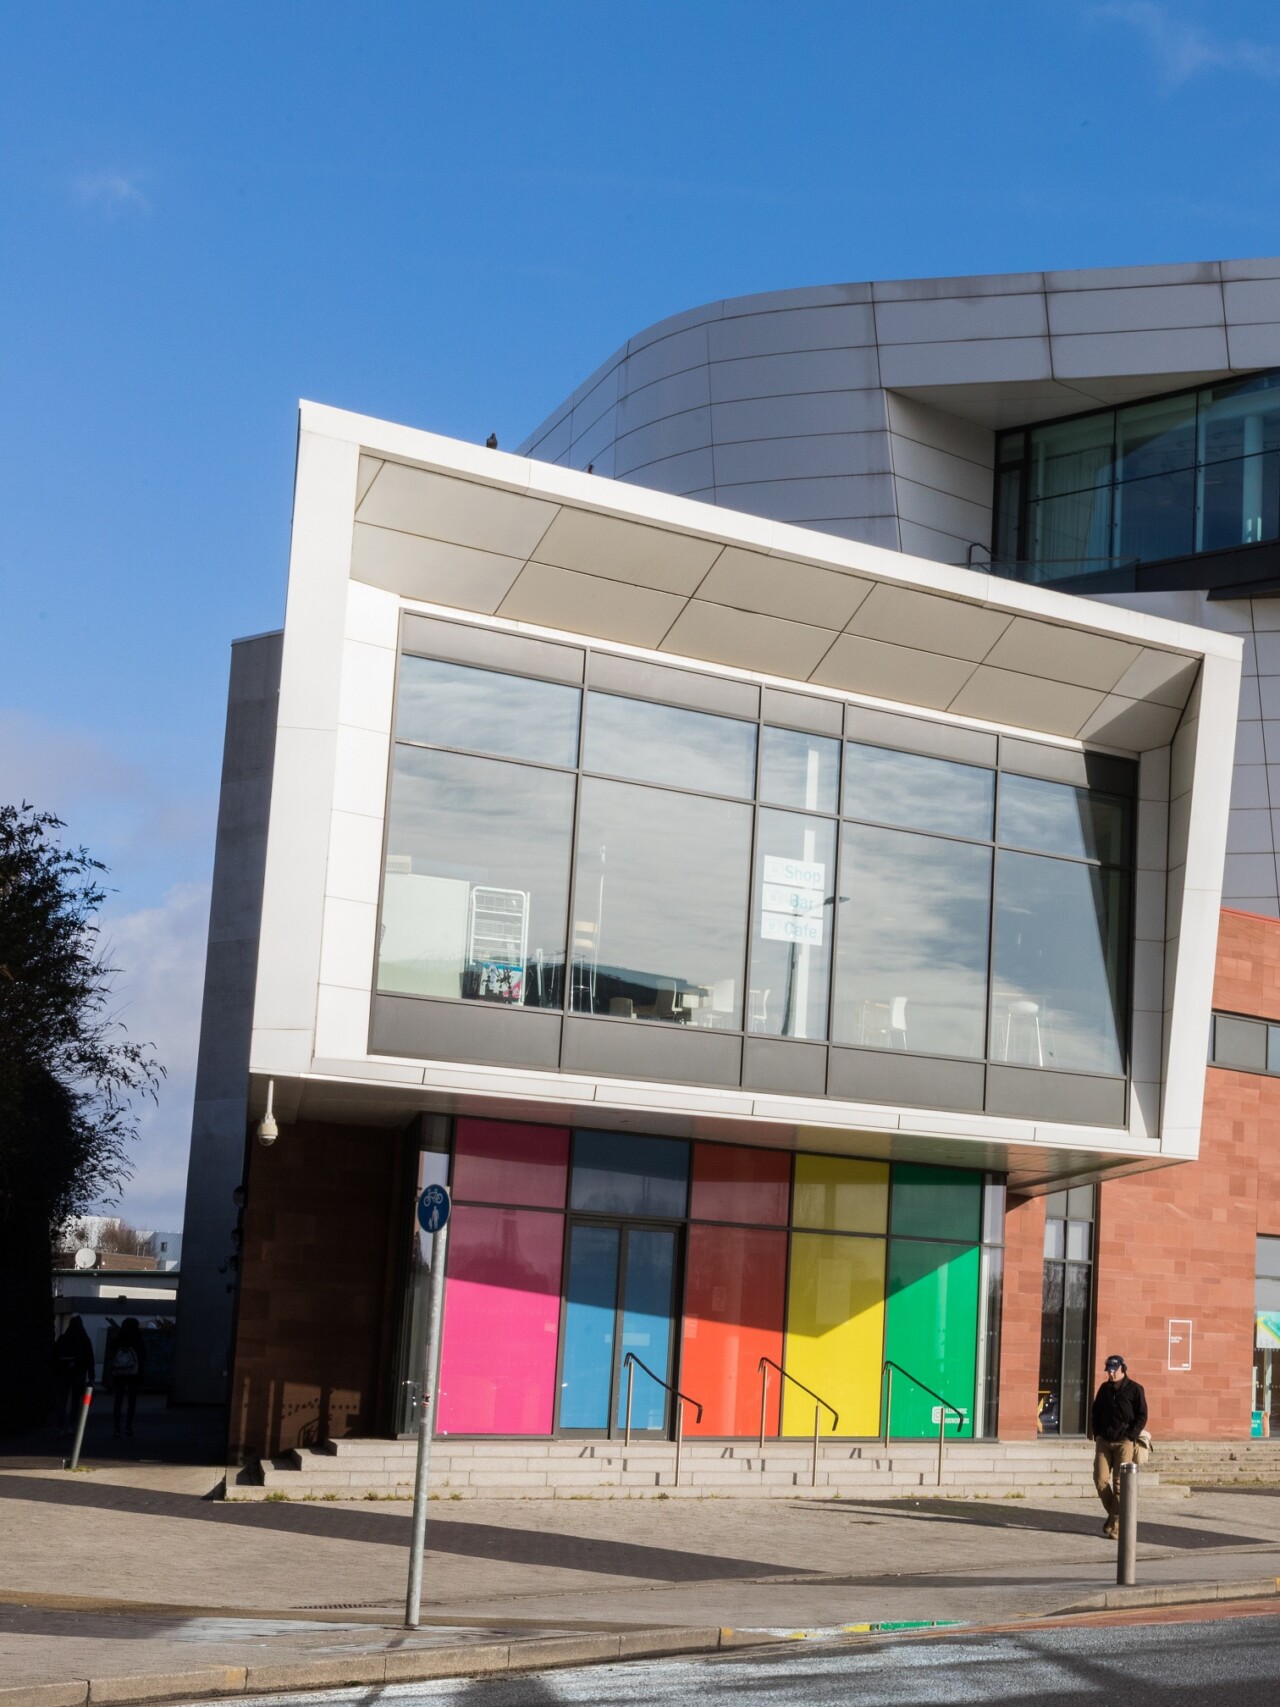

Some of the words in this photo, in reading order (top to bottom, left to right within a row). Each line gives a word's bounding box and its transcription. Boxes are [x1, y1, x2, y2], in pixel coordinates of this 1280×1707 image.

[784, 864, 822, 886] Shop
[789, 893, 813, 911] Bar
[784, 921, 817, 939] Cafe
